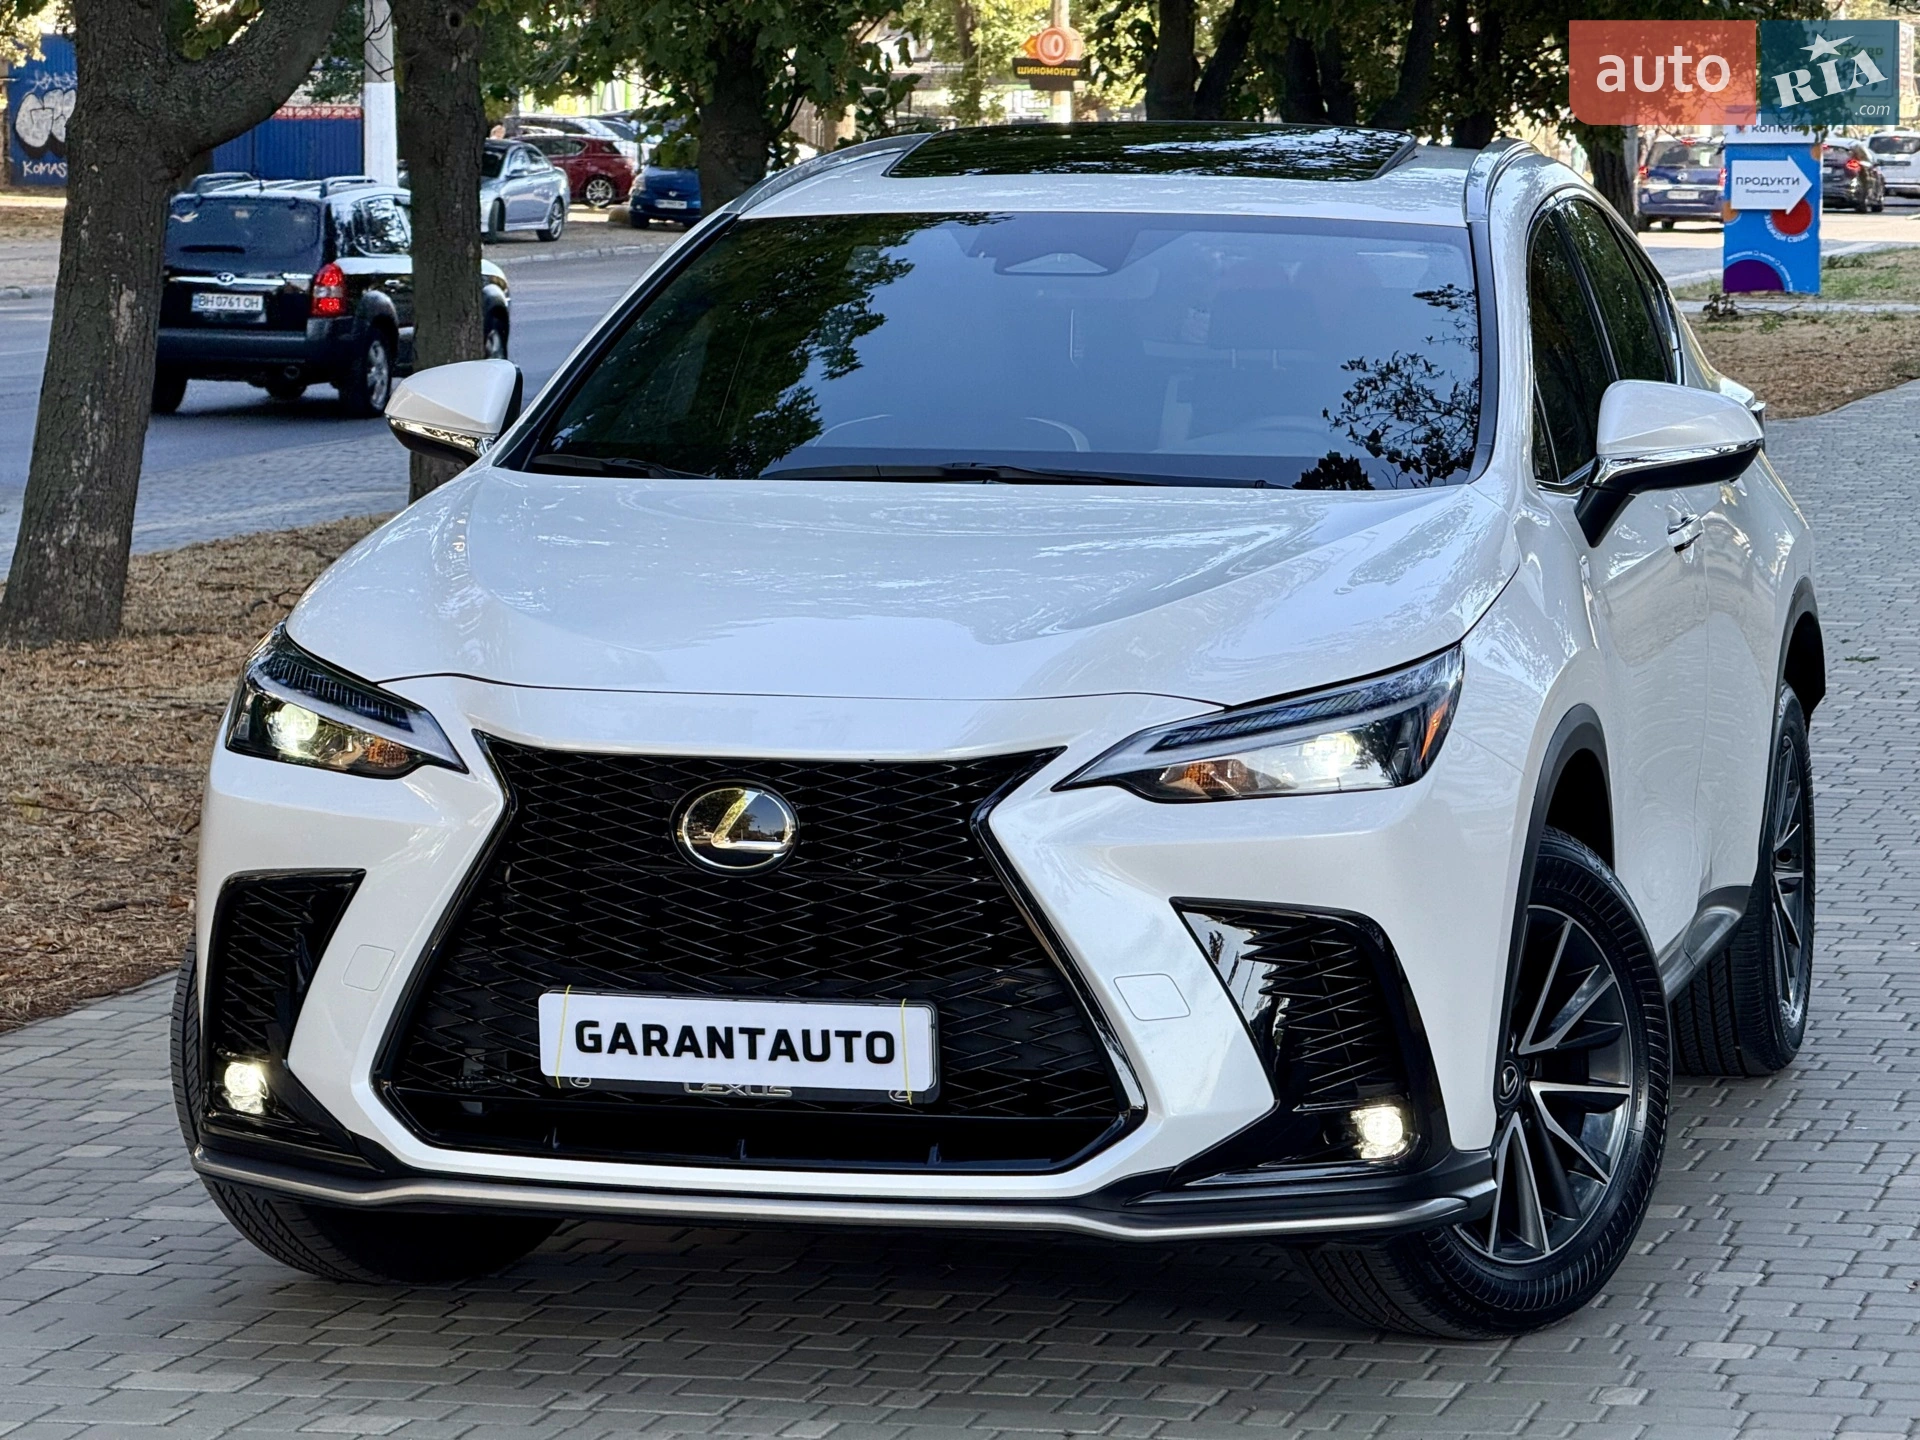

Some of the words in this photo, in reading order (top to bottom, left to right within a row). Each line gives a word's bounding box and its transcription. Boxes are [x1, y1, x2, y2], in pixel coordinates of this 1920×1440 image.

[1735, 176, 1800, 187] ПРОДУКТИ
[574, 1019, 896, 1065] GARANTAUTO
[683, 1082, 793, 1098] LEXUS
